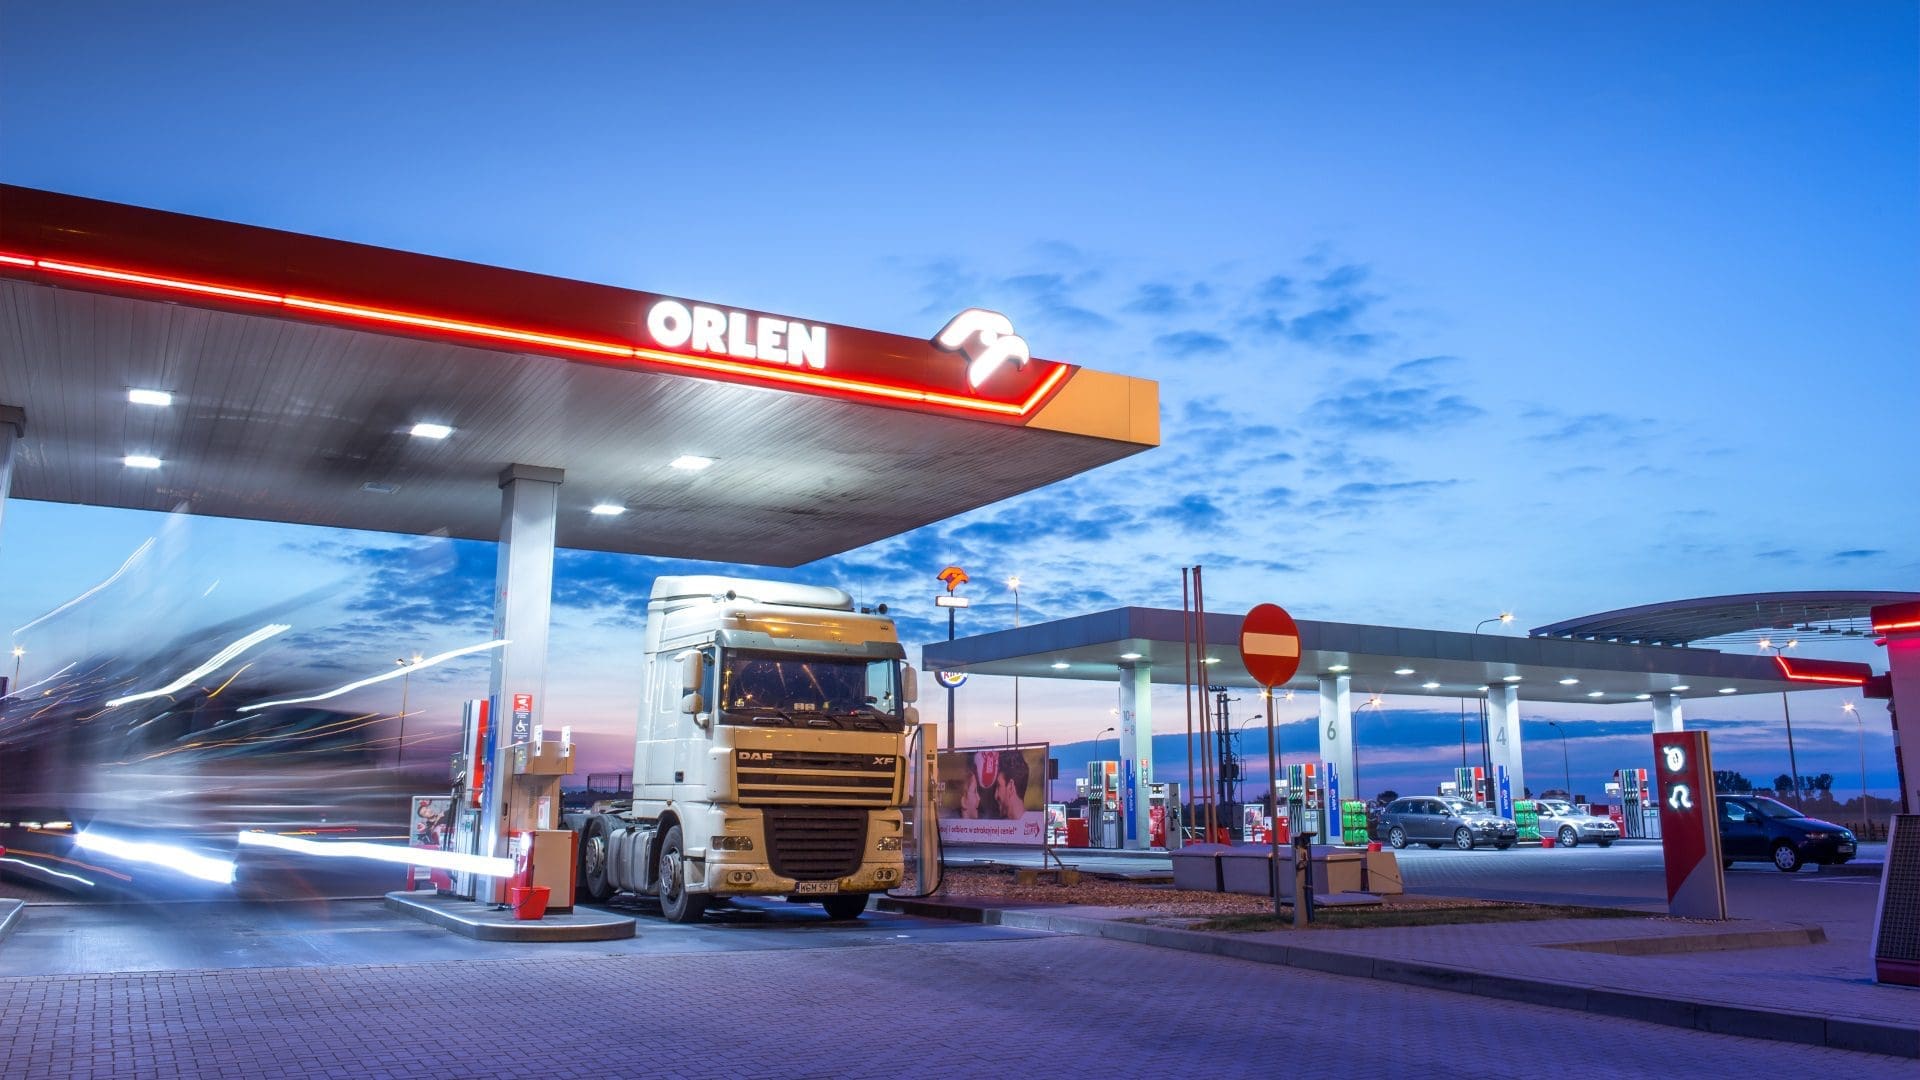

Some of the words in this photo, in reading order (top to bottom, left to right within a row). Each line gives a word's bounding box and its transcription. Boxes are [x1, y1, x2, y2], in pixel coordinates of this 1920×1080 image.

[647, 299, 827, 369] ORLEN
[1326, 720, 1337, 741] 6
[1495, 726, 1507, 746] 4
[738, 751, 774, 761] DAF
[872, 757, 895, 765] XF
